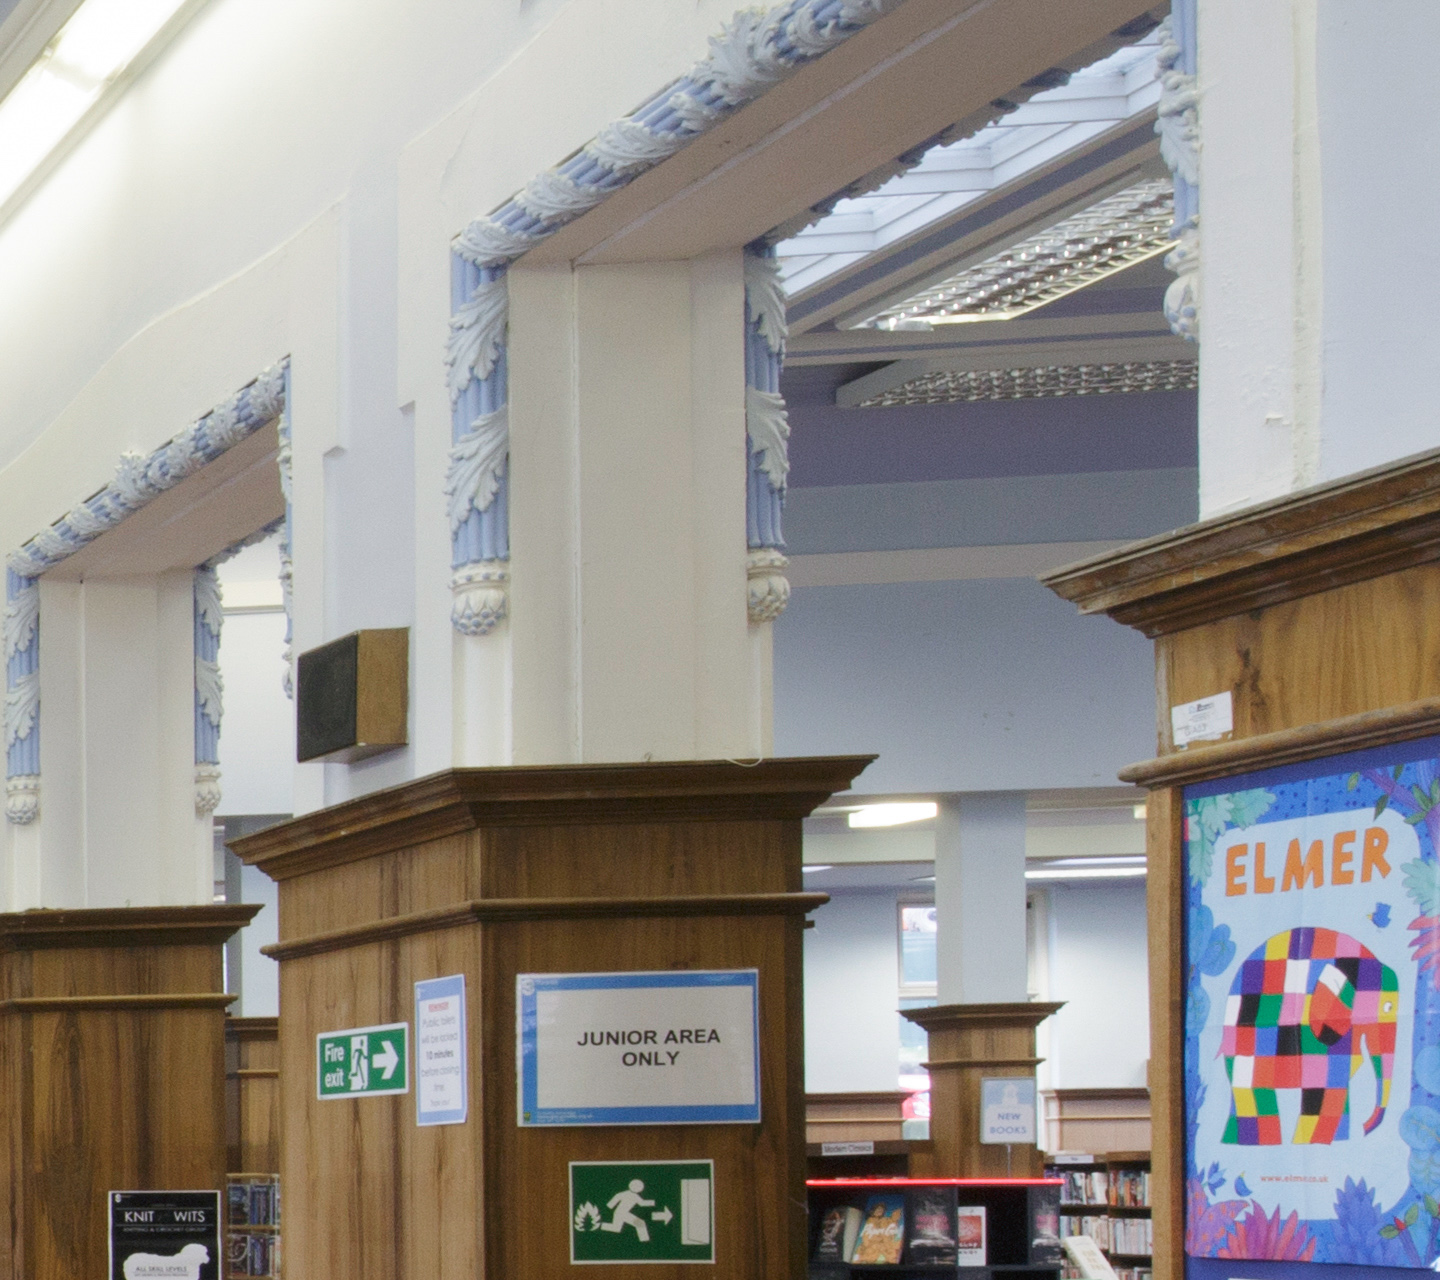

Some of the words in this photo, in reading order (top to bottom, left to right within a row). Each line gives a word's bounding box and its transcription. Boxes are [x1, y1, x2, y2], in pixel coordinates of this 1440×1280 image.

[1225, 826, 1392, 897] ELMER
[577, 1029, 659, 1047] JUNIOR
[663, 1028, 721, 1045] AREA
[324, 1041, 345, 1063] Fire
[621, 1050, 681, 1068] ONLY
[324, 1068, 345, 1089] exit
[997, 1112, 1022, 1121] NEW
[989, 1125, 1028, 1135] BOOKS
[124, 1210, 155, 1223] KNIT
[173, 1210, 206, 1223] WITS
